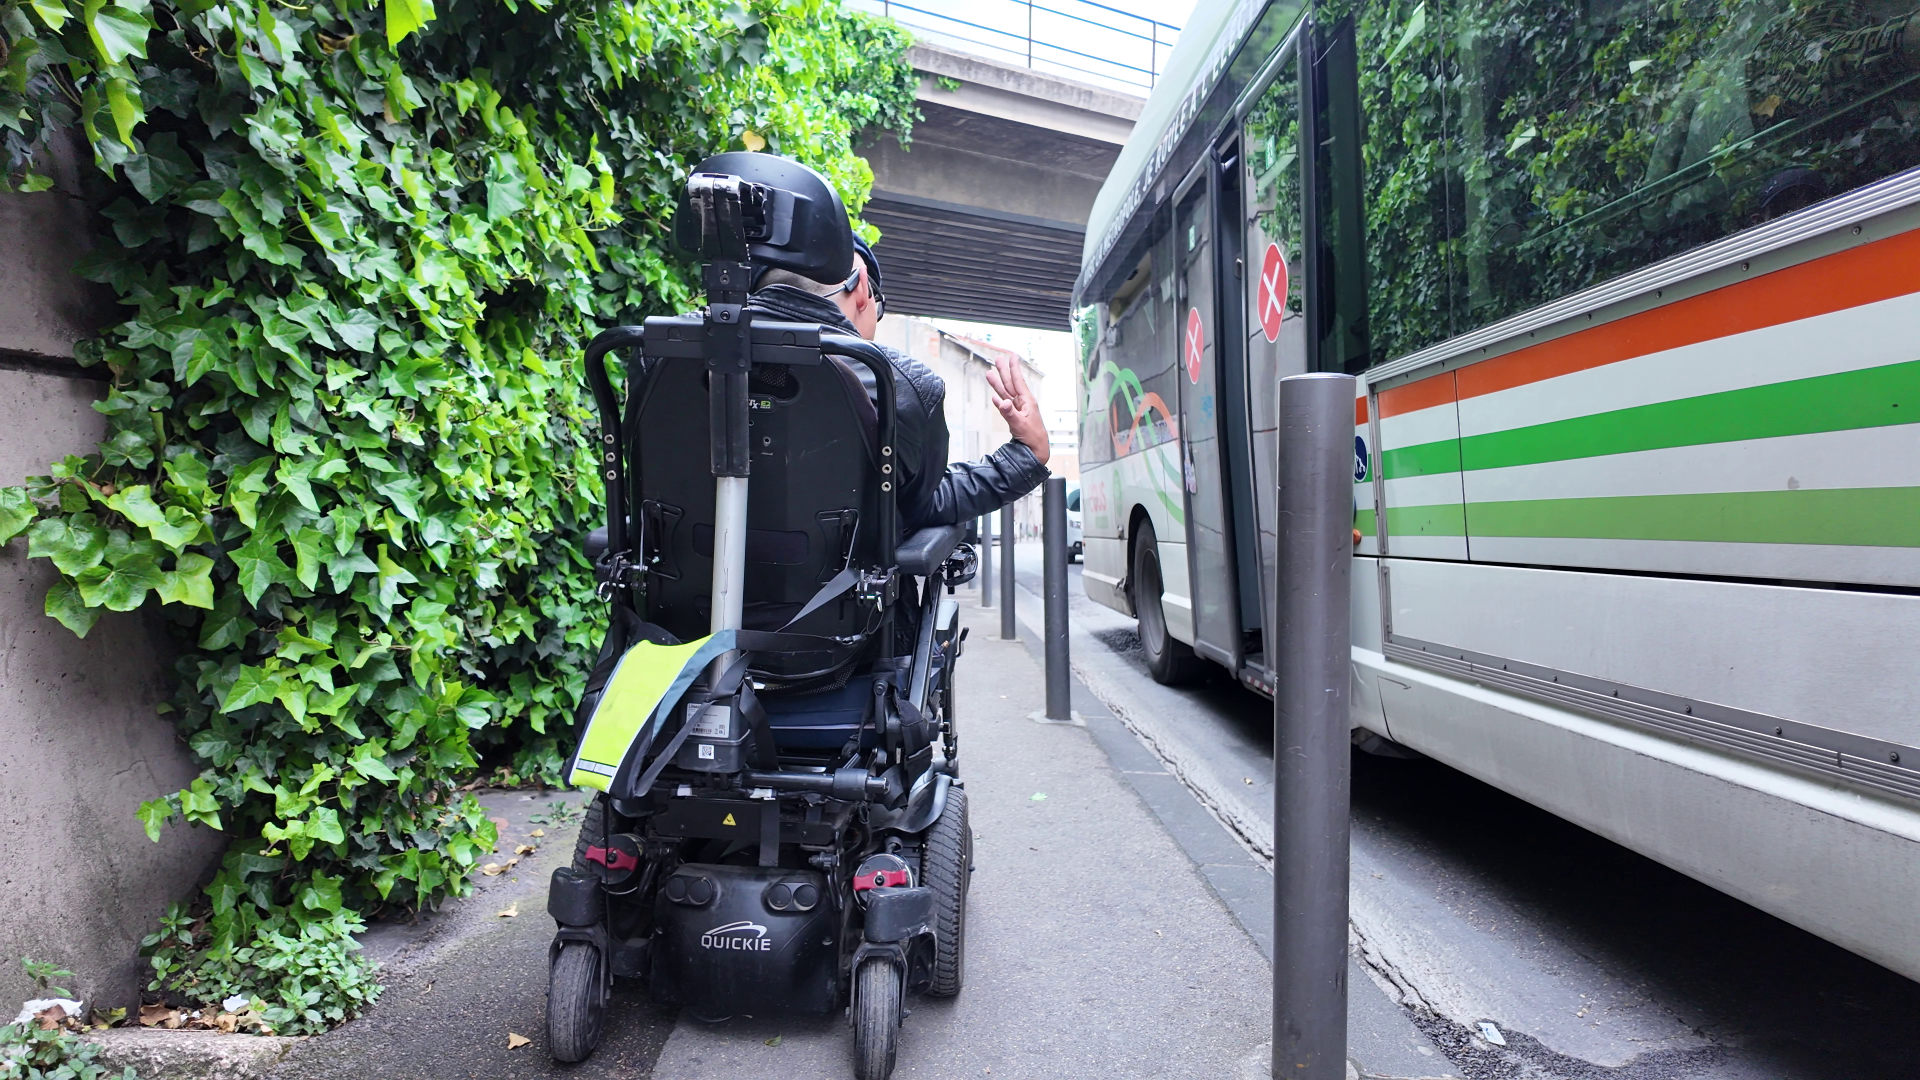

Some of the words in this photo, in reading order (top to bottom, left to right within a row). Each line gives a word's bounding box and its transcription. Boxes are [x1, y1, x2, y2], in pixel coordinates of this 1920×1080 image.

[1143, 157, 1155, 192] JE
[1155, 101, 1188, 173] ROULE
[701, 935, 771, 951] QUICKIE
